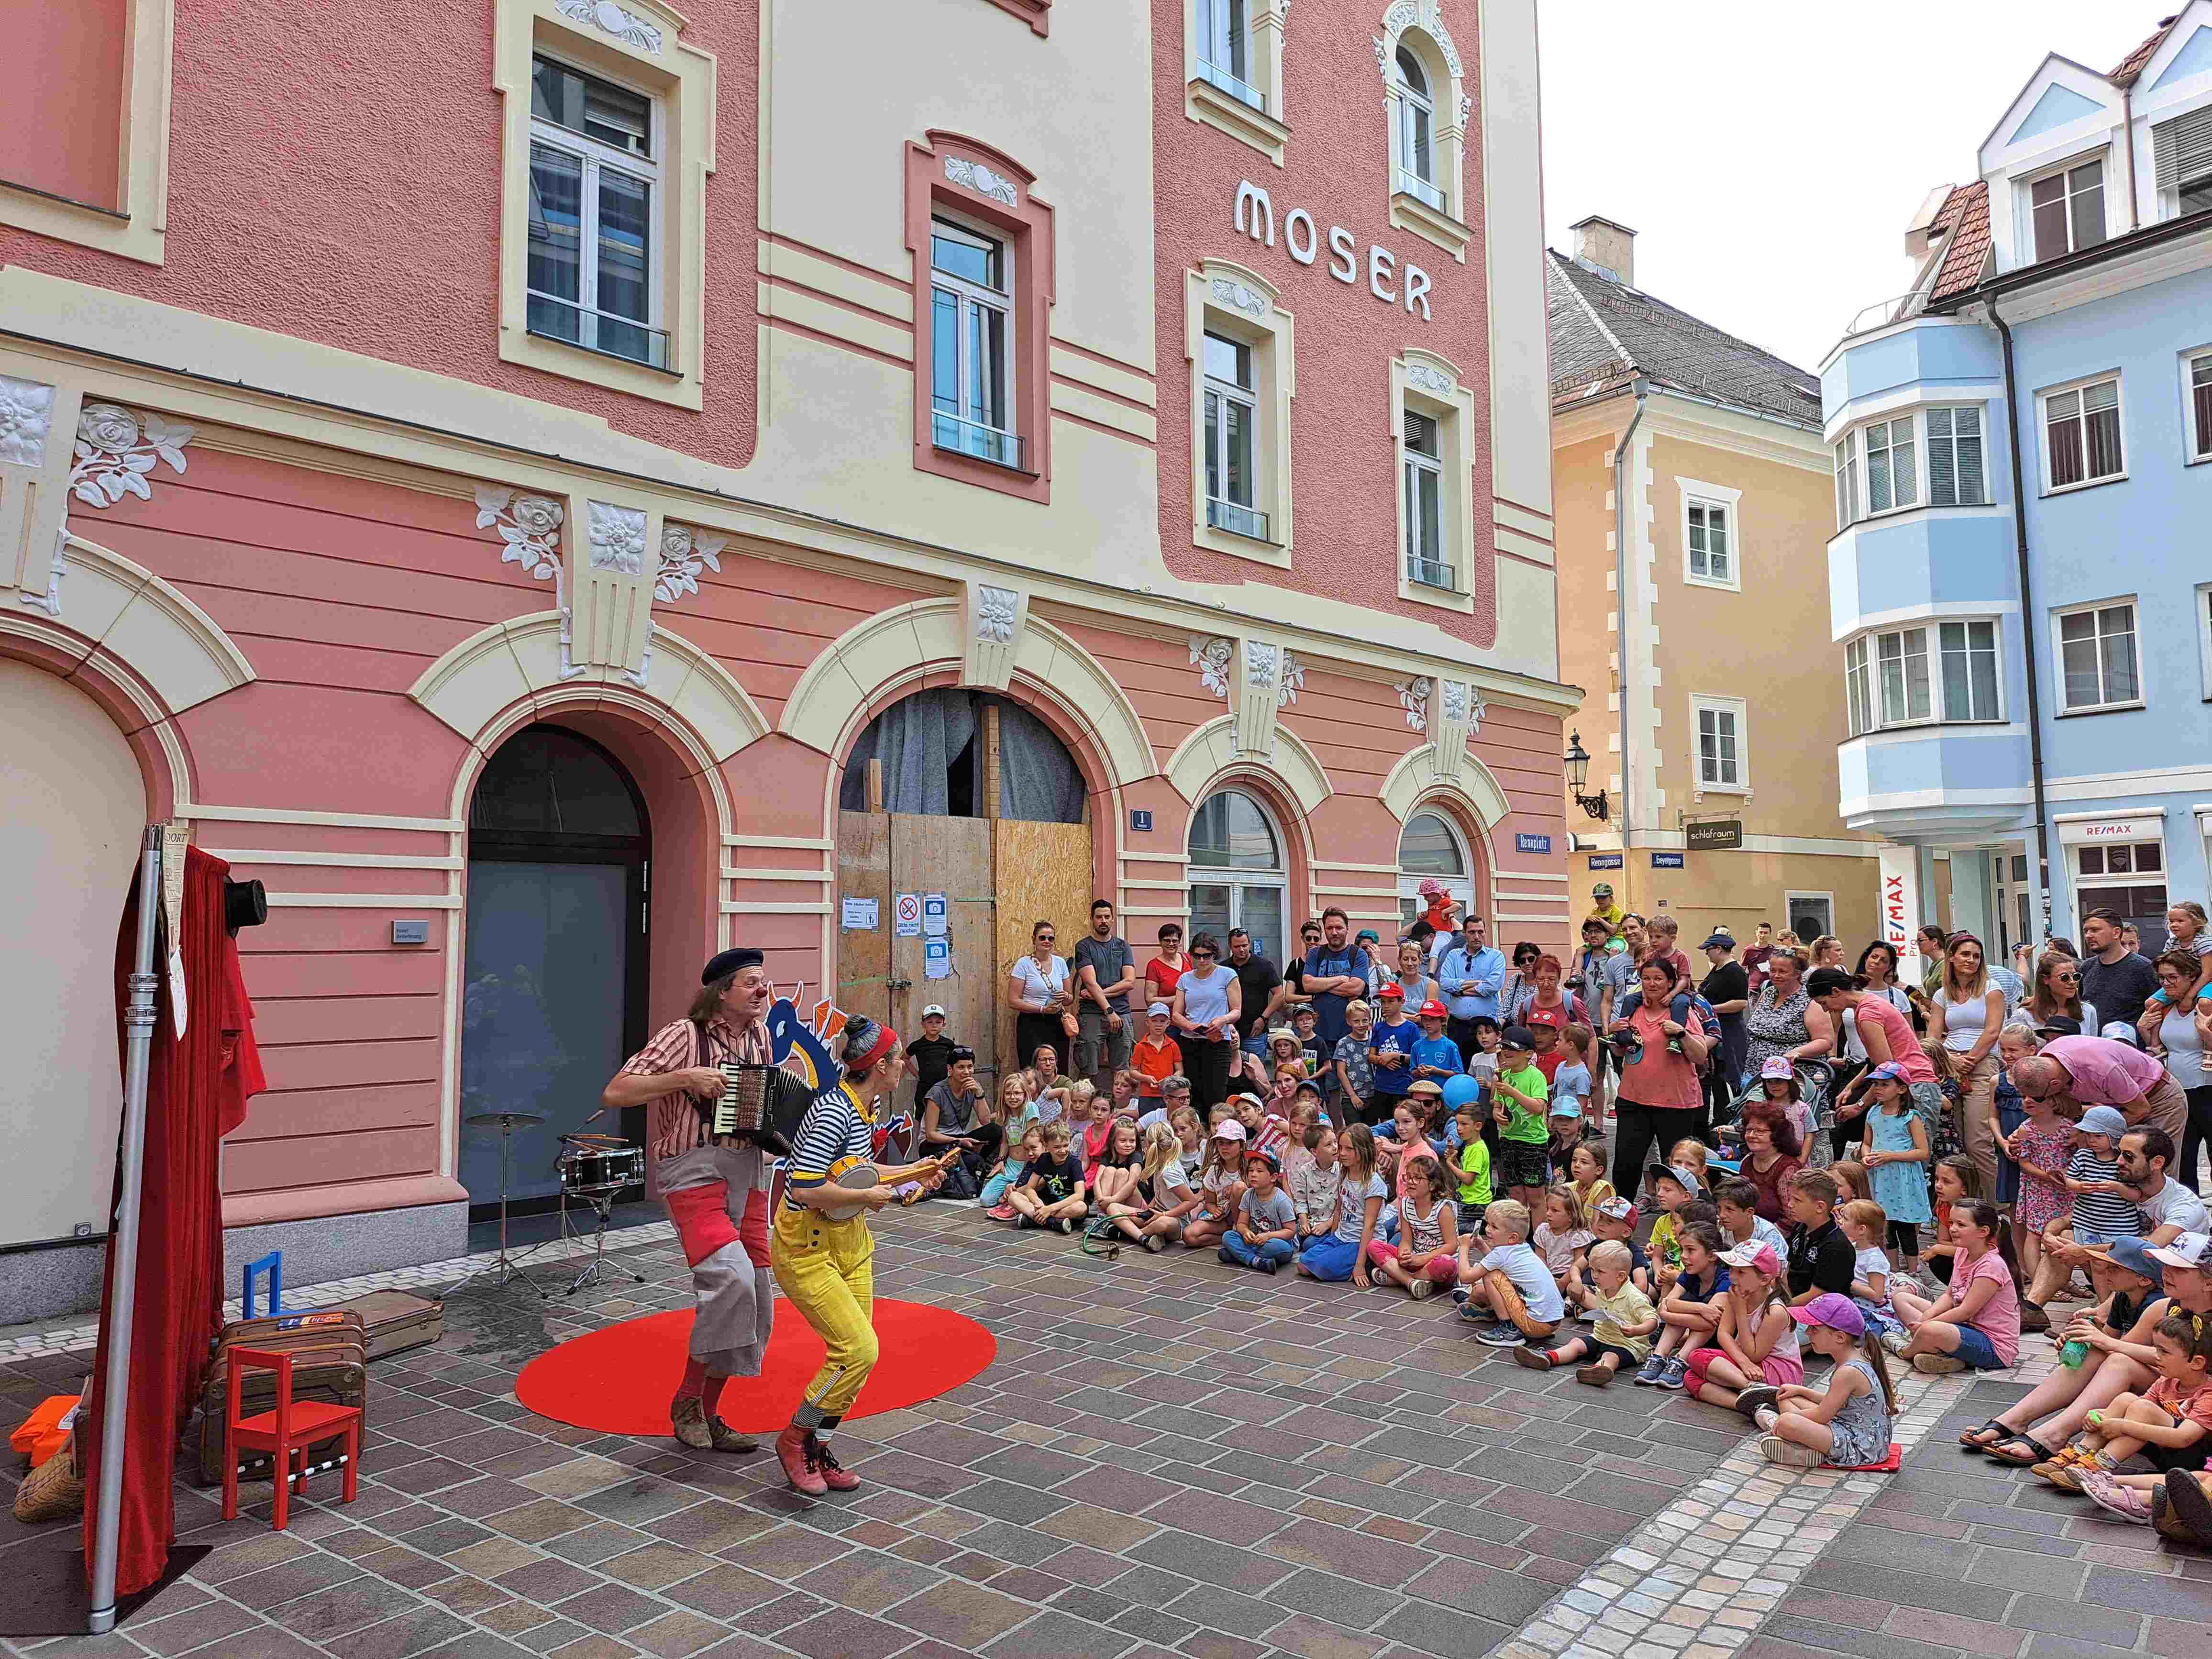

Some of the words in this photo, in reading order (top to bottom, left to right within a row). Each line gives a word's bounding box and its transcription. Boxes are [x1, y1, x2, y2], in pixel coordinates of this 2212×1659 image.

[1234, 179, 1431, 322] MOSER
[1140, 812, 1145, 824] 1
[1691, 828, 1734, 840] schlafraum
[2086, 825, 2131, 835] RE/MAX
[1520, 834, 1547, 851] Rennplatz
[1591, 858, 1621, 868] Renngasse
[1887, 875, 1906, 957] RE/MAX
